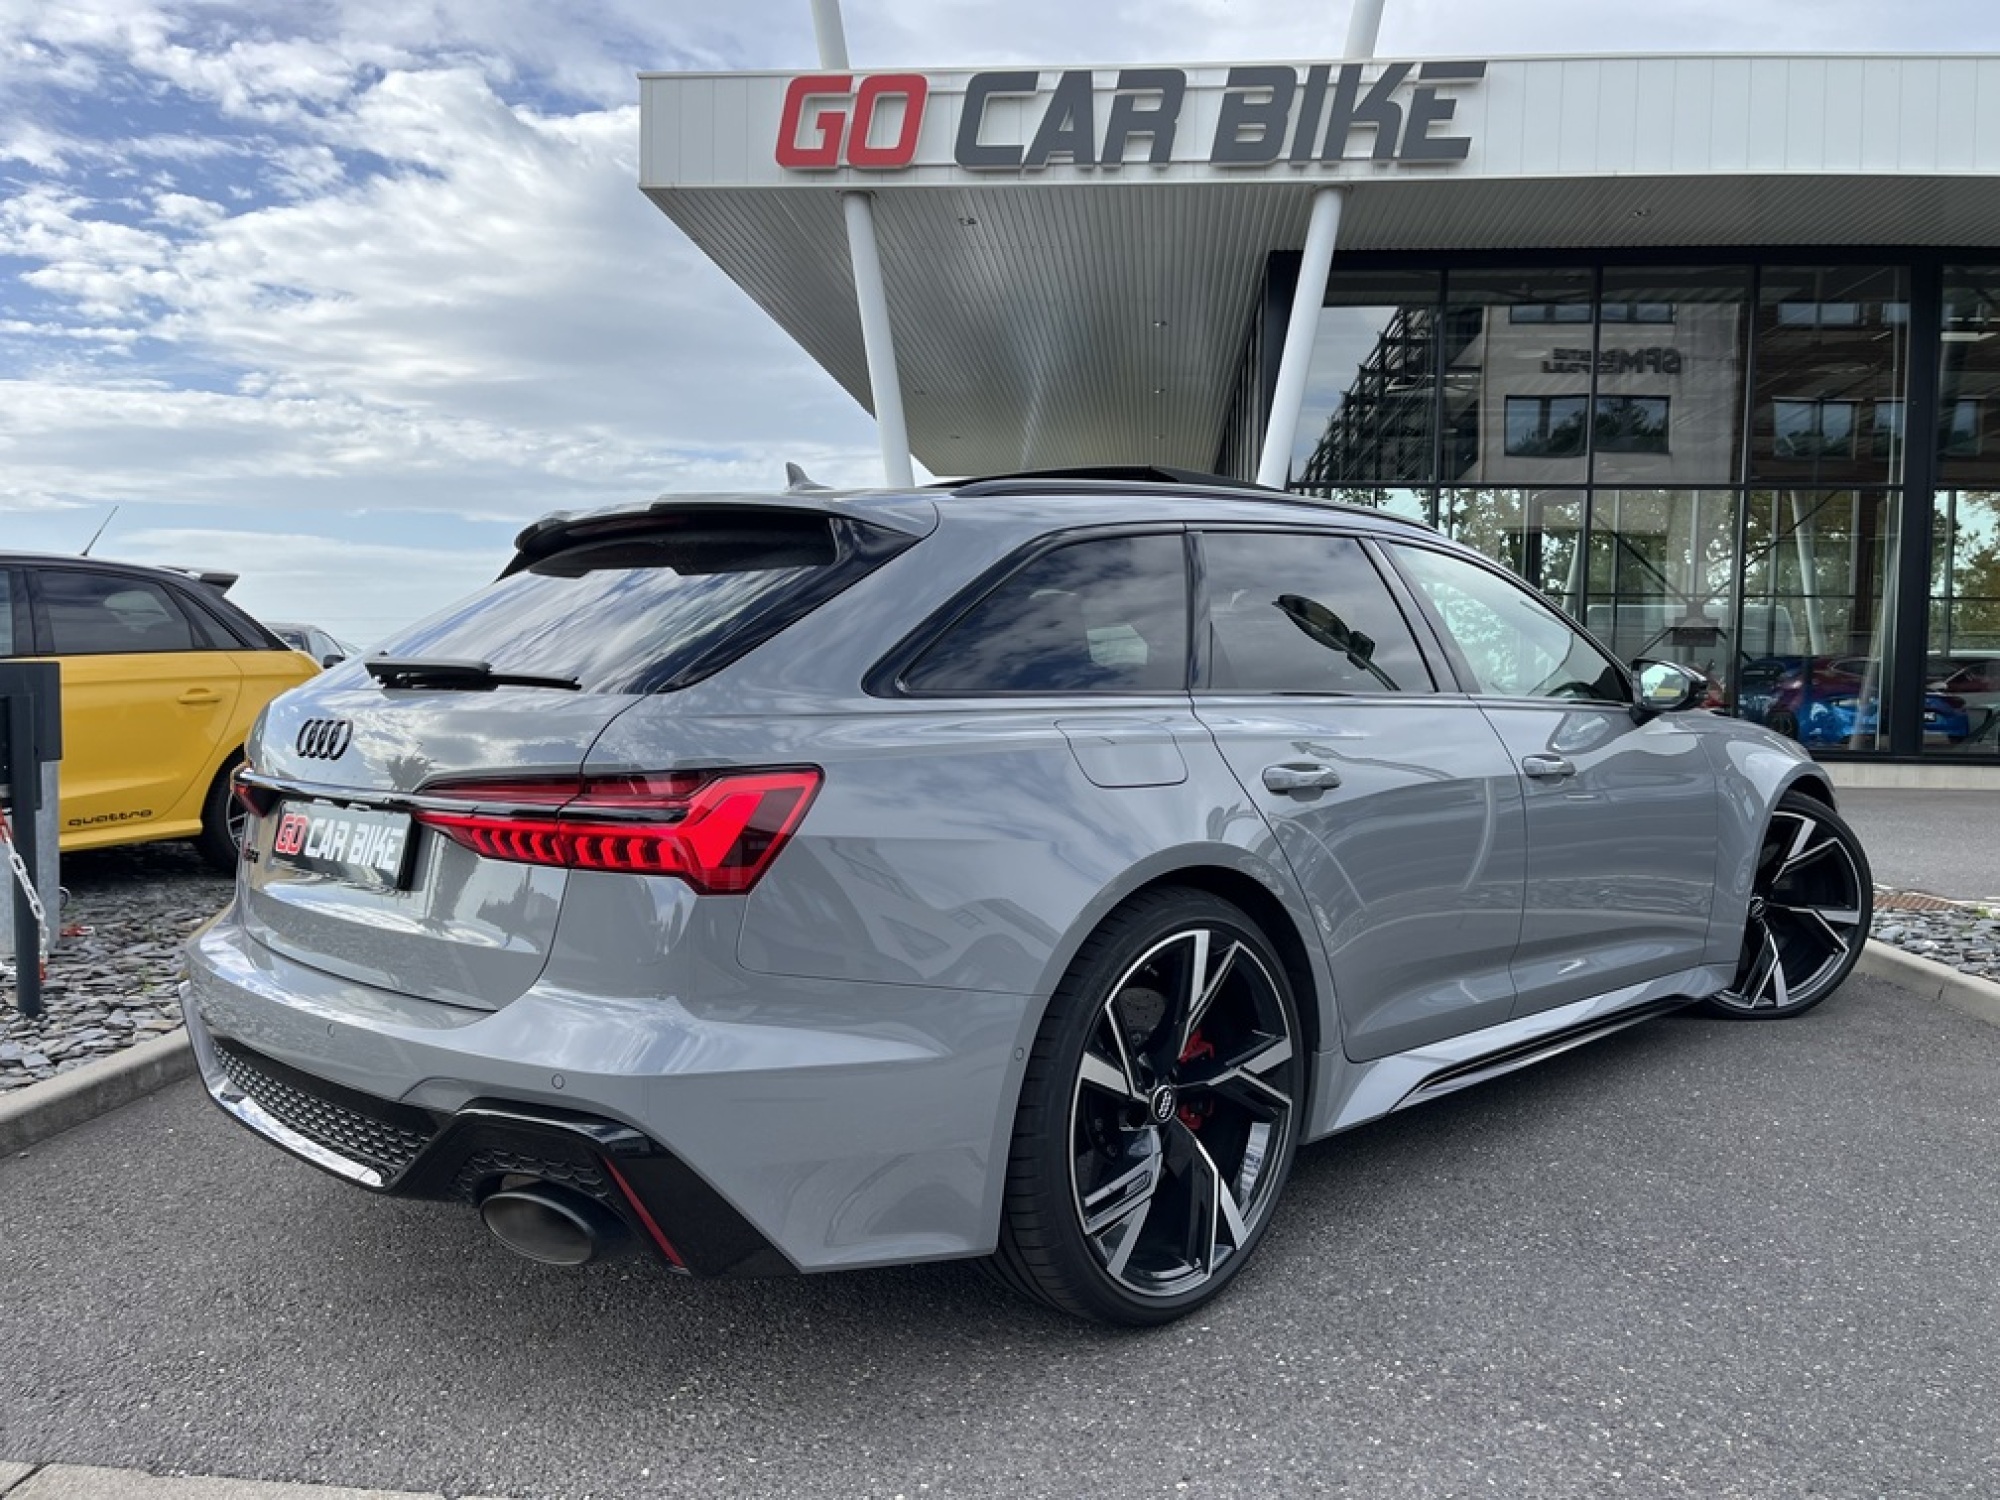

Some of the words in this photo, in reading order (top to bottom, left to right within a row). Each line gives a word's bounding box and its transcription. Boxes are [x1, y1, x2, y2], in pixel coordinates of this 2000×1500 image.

[775, 73, 928, 169] GO
[956, 67, 1187, 170] CAR
[1211, 60, 1487, 167] BIKE
[68, 809, 152, 826] quattro
[276, 813, 308, 854] GO
[304, 818, 349, 862] CAR
[347, 823, 404, 870] BIKE
